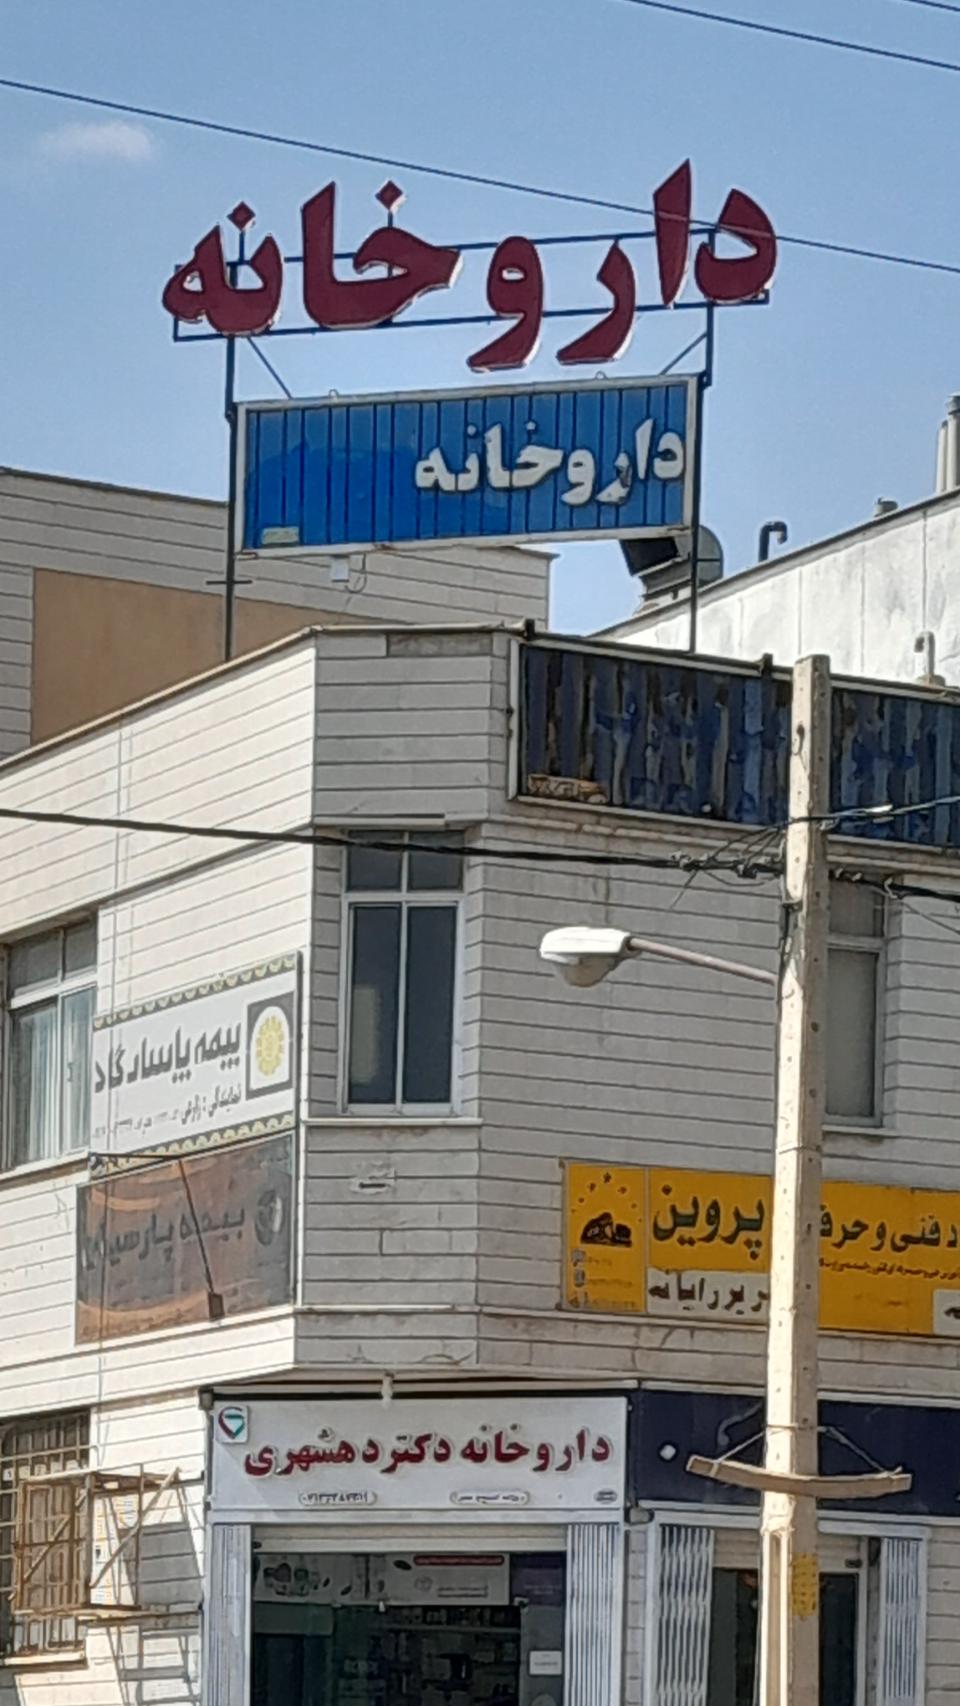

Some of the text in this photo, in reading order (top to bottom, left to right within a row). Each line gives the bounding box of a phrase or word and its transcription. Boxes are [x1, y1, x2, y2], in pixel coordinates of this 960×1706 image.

[162, 158, 777, 371] داروخانه
[413, 418, 685, 505] داروخانه
[94, 1022, 242, 1093] بیمه پاسارگاد
[180, 1207, 245, 1241] بیمه
[652, 1183, 766, 1262] پروین
[819, 1203, 870, 1250] حرف
[870, 1221, 887, 1252] و
[890, 1215, 941, 1253] فنی
[648, 1268, 720, 1311] رایانه
[380, 1432, 451, 1475] دکتر
[461, 1422, 611, 1473] داروخانه
